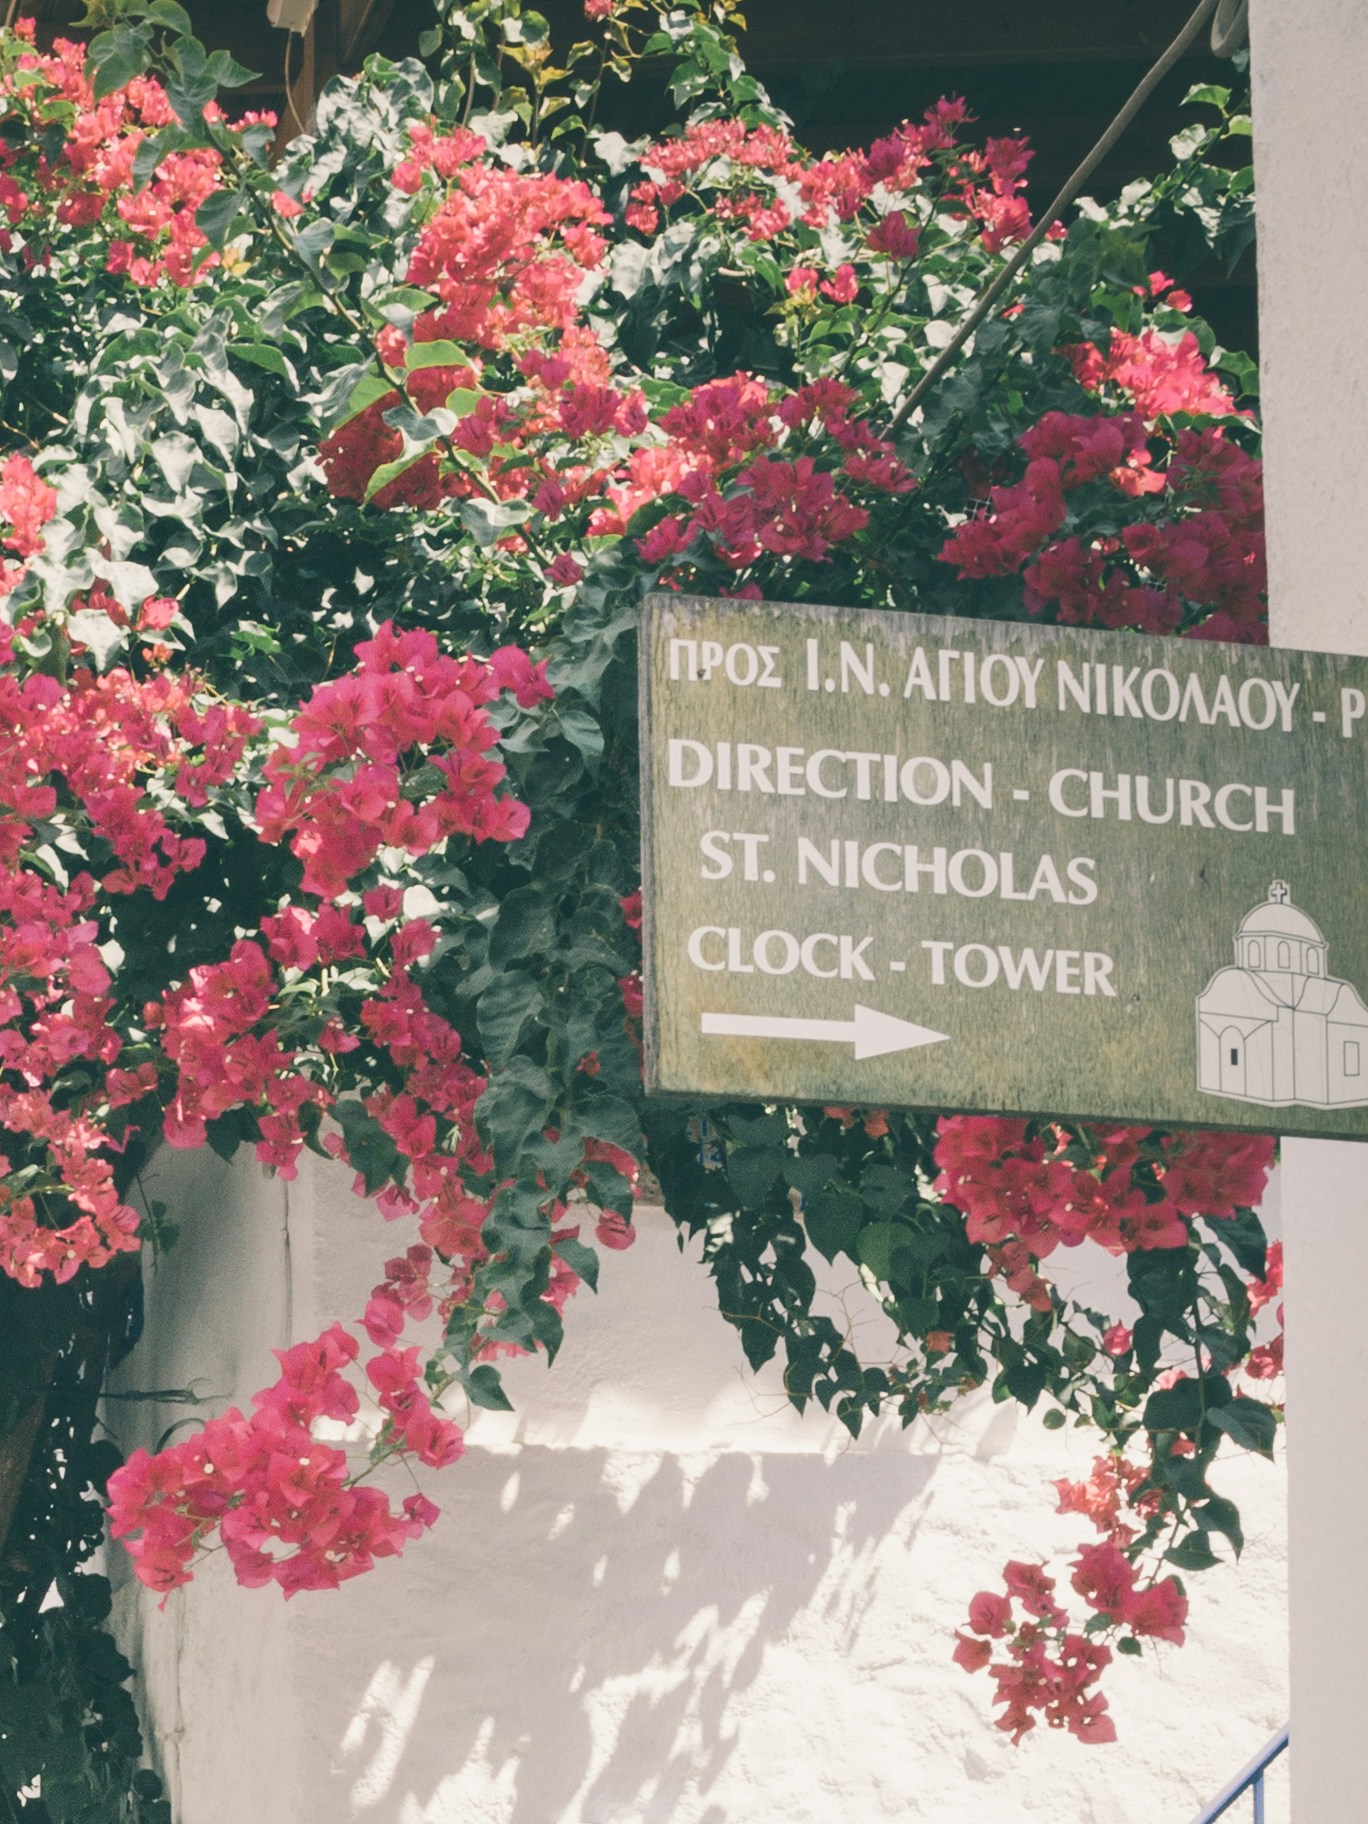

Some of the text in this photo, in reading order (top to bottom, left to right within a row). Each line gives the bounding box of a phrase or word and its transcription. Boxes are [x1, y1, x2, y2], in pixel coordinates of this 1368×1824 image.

[668, 638, 782, 689] ΠΡΟΣ
[903, 646, 1045, 709] ΑΓΙΟΥ
[1057, 659, 1301, 732] ΝΙΚΟΛΑΟΥ
[667, 738, 993, 810] DIRECTION
[1048, 768, 1296, 836] CHURCH
[698, 830, 1099, 906] ST. NICHOLAS
[686, 924, 876, 981] CLOCK
[921, 939, 1118, 997] TOWER
